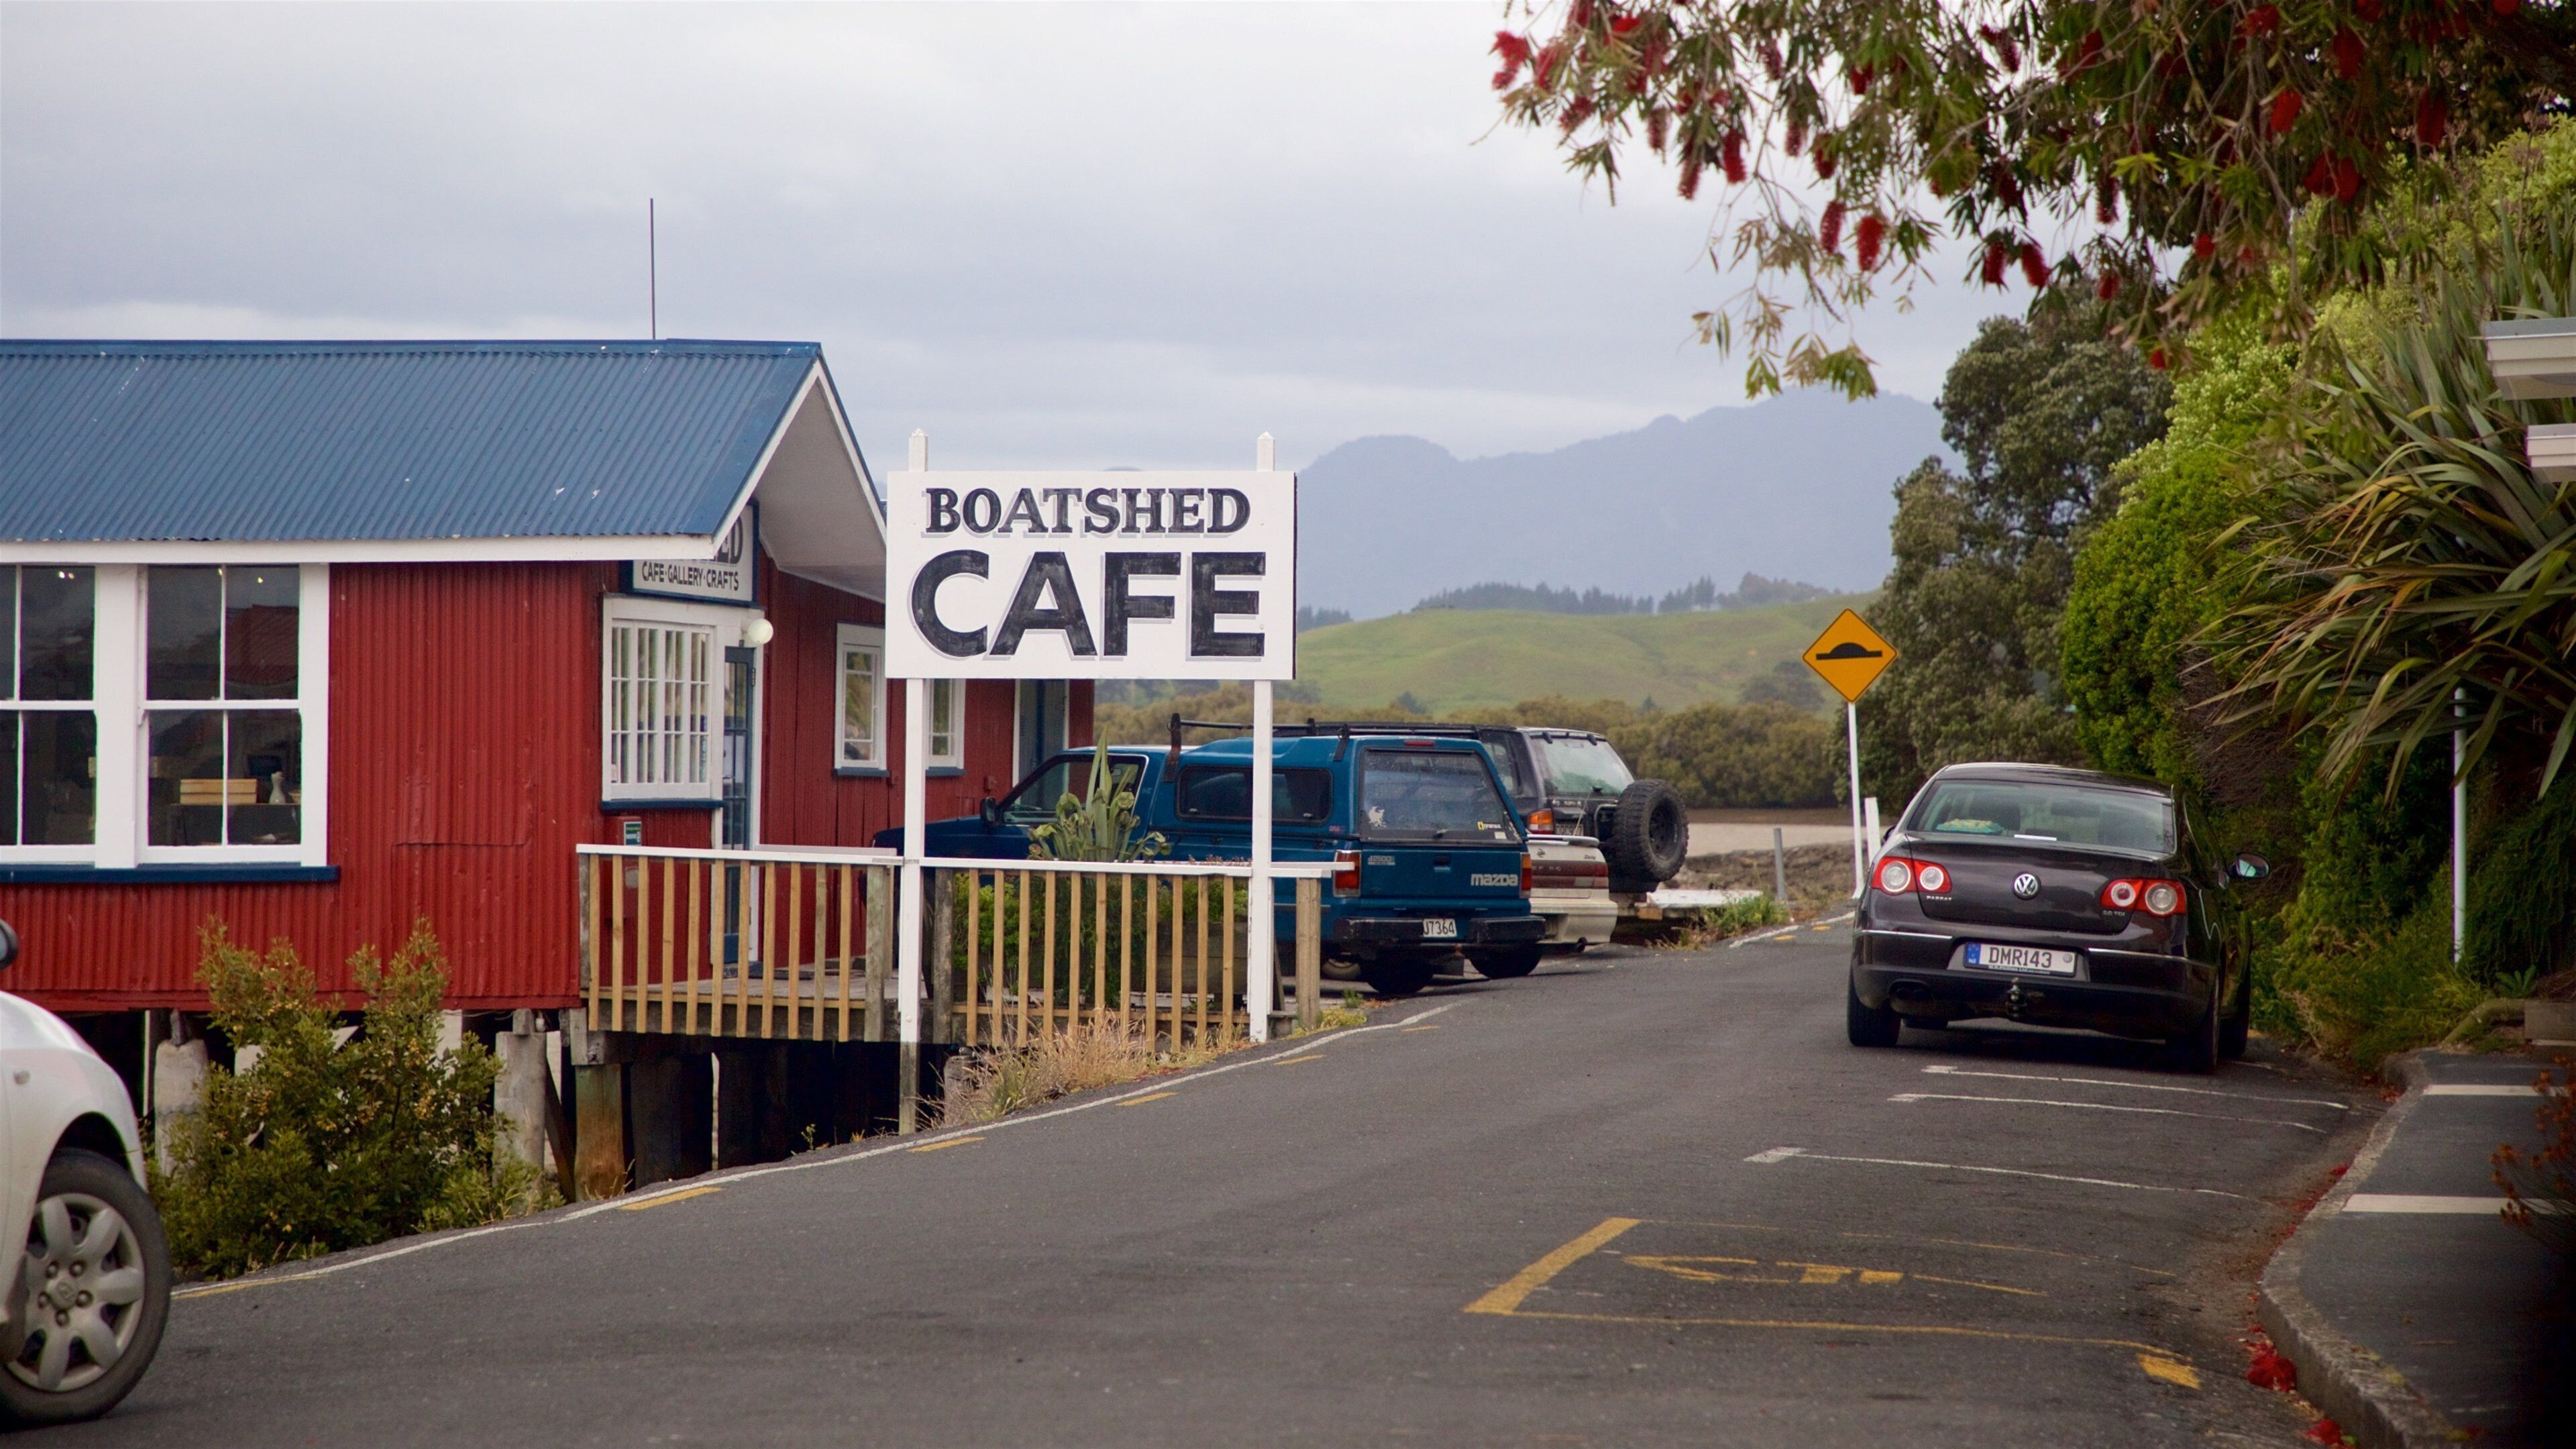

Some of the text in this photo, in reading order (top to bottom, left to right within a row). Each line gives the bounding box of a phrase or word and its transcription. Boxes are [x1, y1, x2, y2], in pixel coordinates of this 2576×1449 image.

[924, 487, 1251, 535] BOATSHED
[642, 561, 739, 591] CAFE GALLERY CRAFTS
[910, 549, 1267, 659] CAFE
[1988, 947, 2052, 968] DMR143
